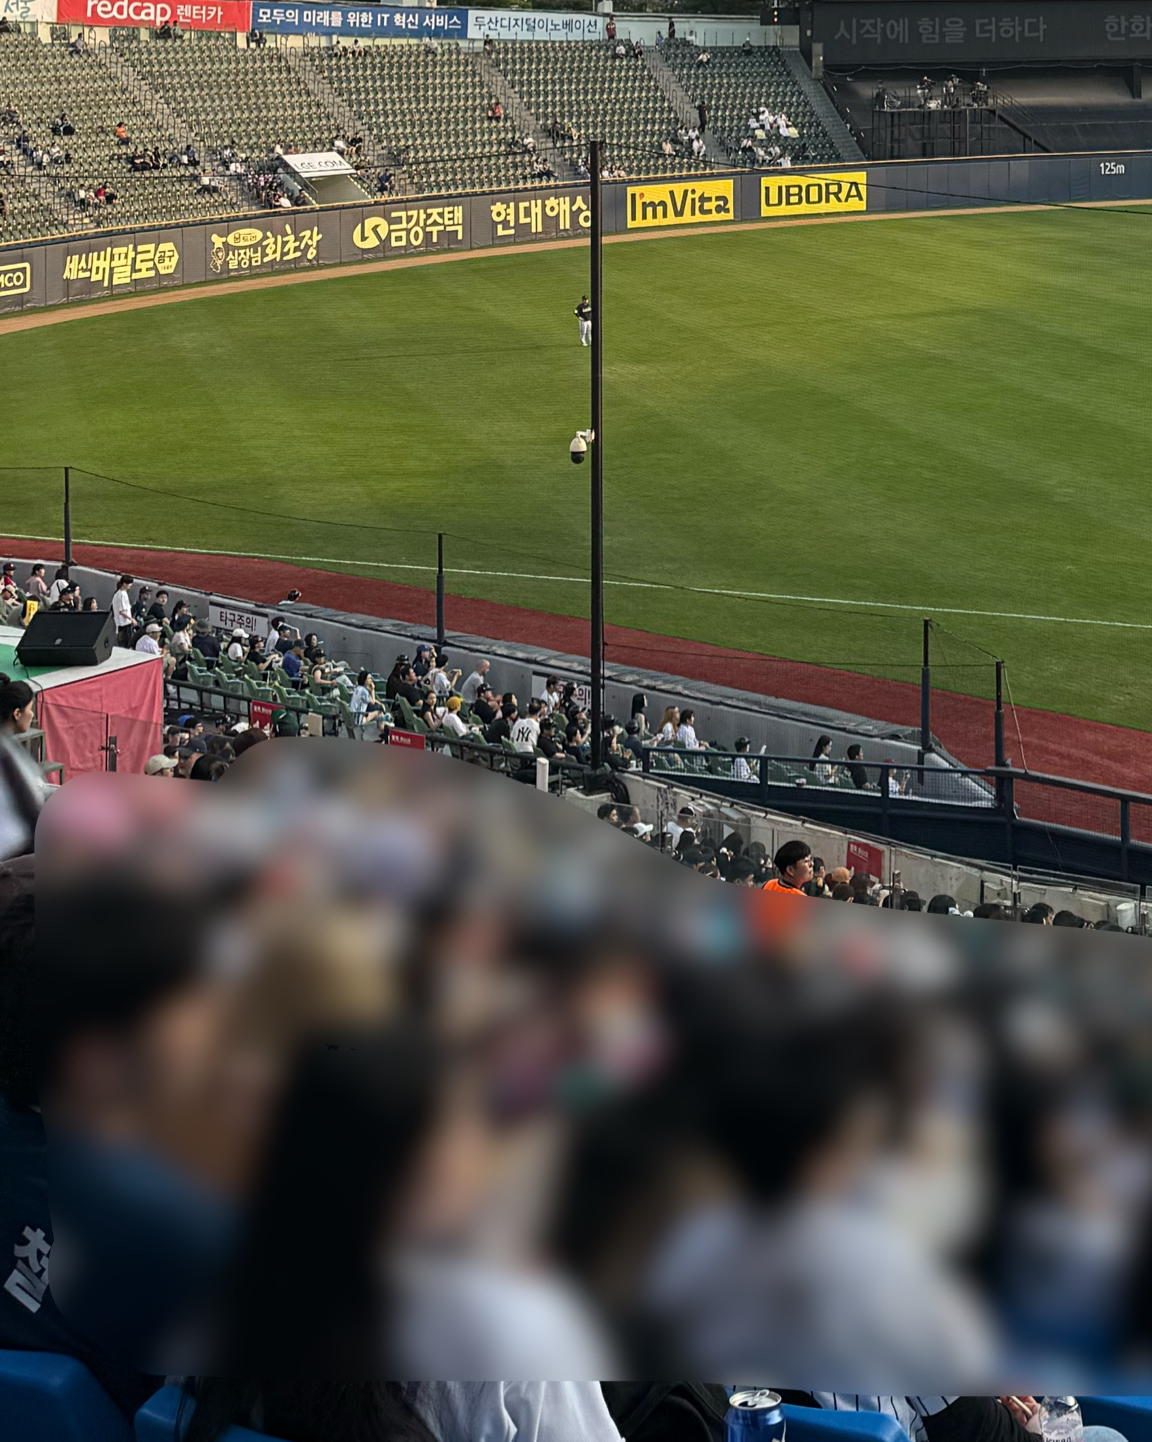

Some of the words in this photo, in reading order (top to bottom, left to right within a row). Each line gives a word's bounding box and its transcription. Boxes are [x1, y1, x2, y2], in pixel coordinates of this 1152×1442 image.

[176, 4, 223, 24] 렌터카
[257, 9, 299, 26] 모두의
[303, 10, 343, 27] 미래를
[346, 11, 373, 28] 위한
[377, 13, 388, 27] IT
[393, 12, 419, 30] 혁신
[422, 13, 462, 30] 서비스
[473, 14, 598, 34] 두산디지털이노베이션
[834, 16, 910, 45] 시작에
[917, 16, 967, 44] 힘을
[975, 15, 1047, 44] 더하다
[1100, 162, 1125, 175] 125m
[764, 181, 864, 207] UBORA
[390, 206, 462, 248] 금강주택
[157, 249, 175, 264] 공구
[226, 247, 261, 269] 실장님
[262, 224, 322, 263] 회초장
[63, 244, 156, 288] 세신버팔로
[220, 611, 256, 632] 타구주의!
